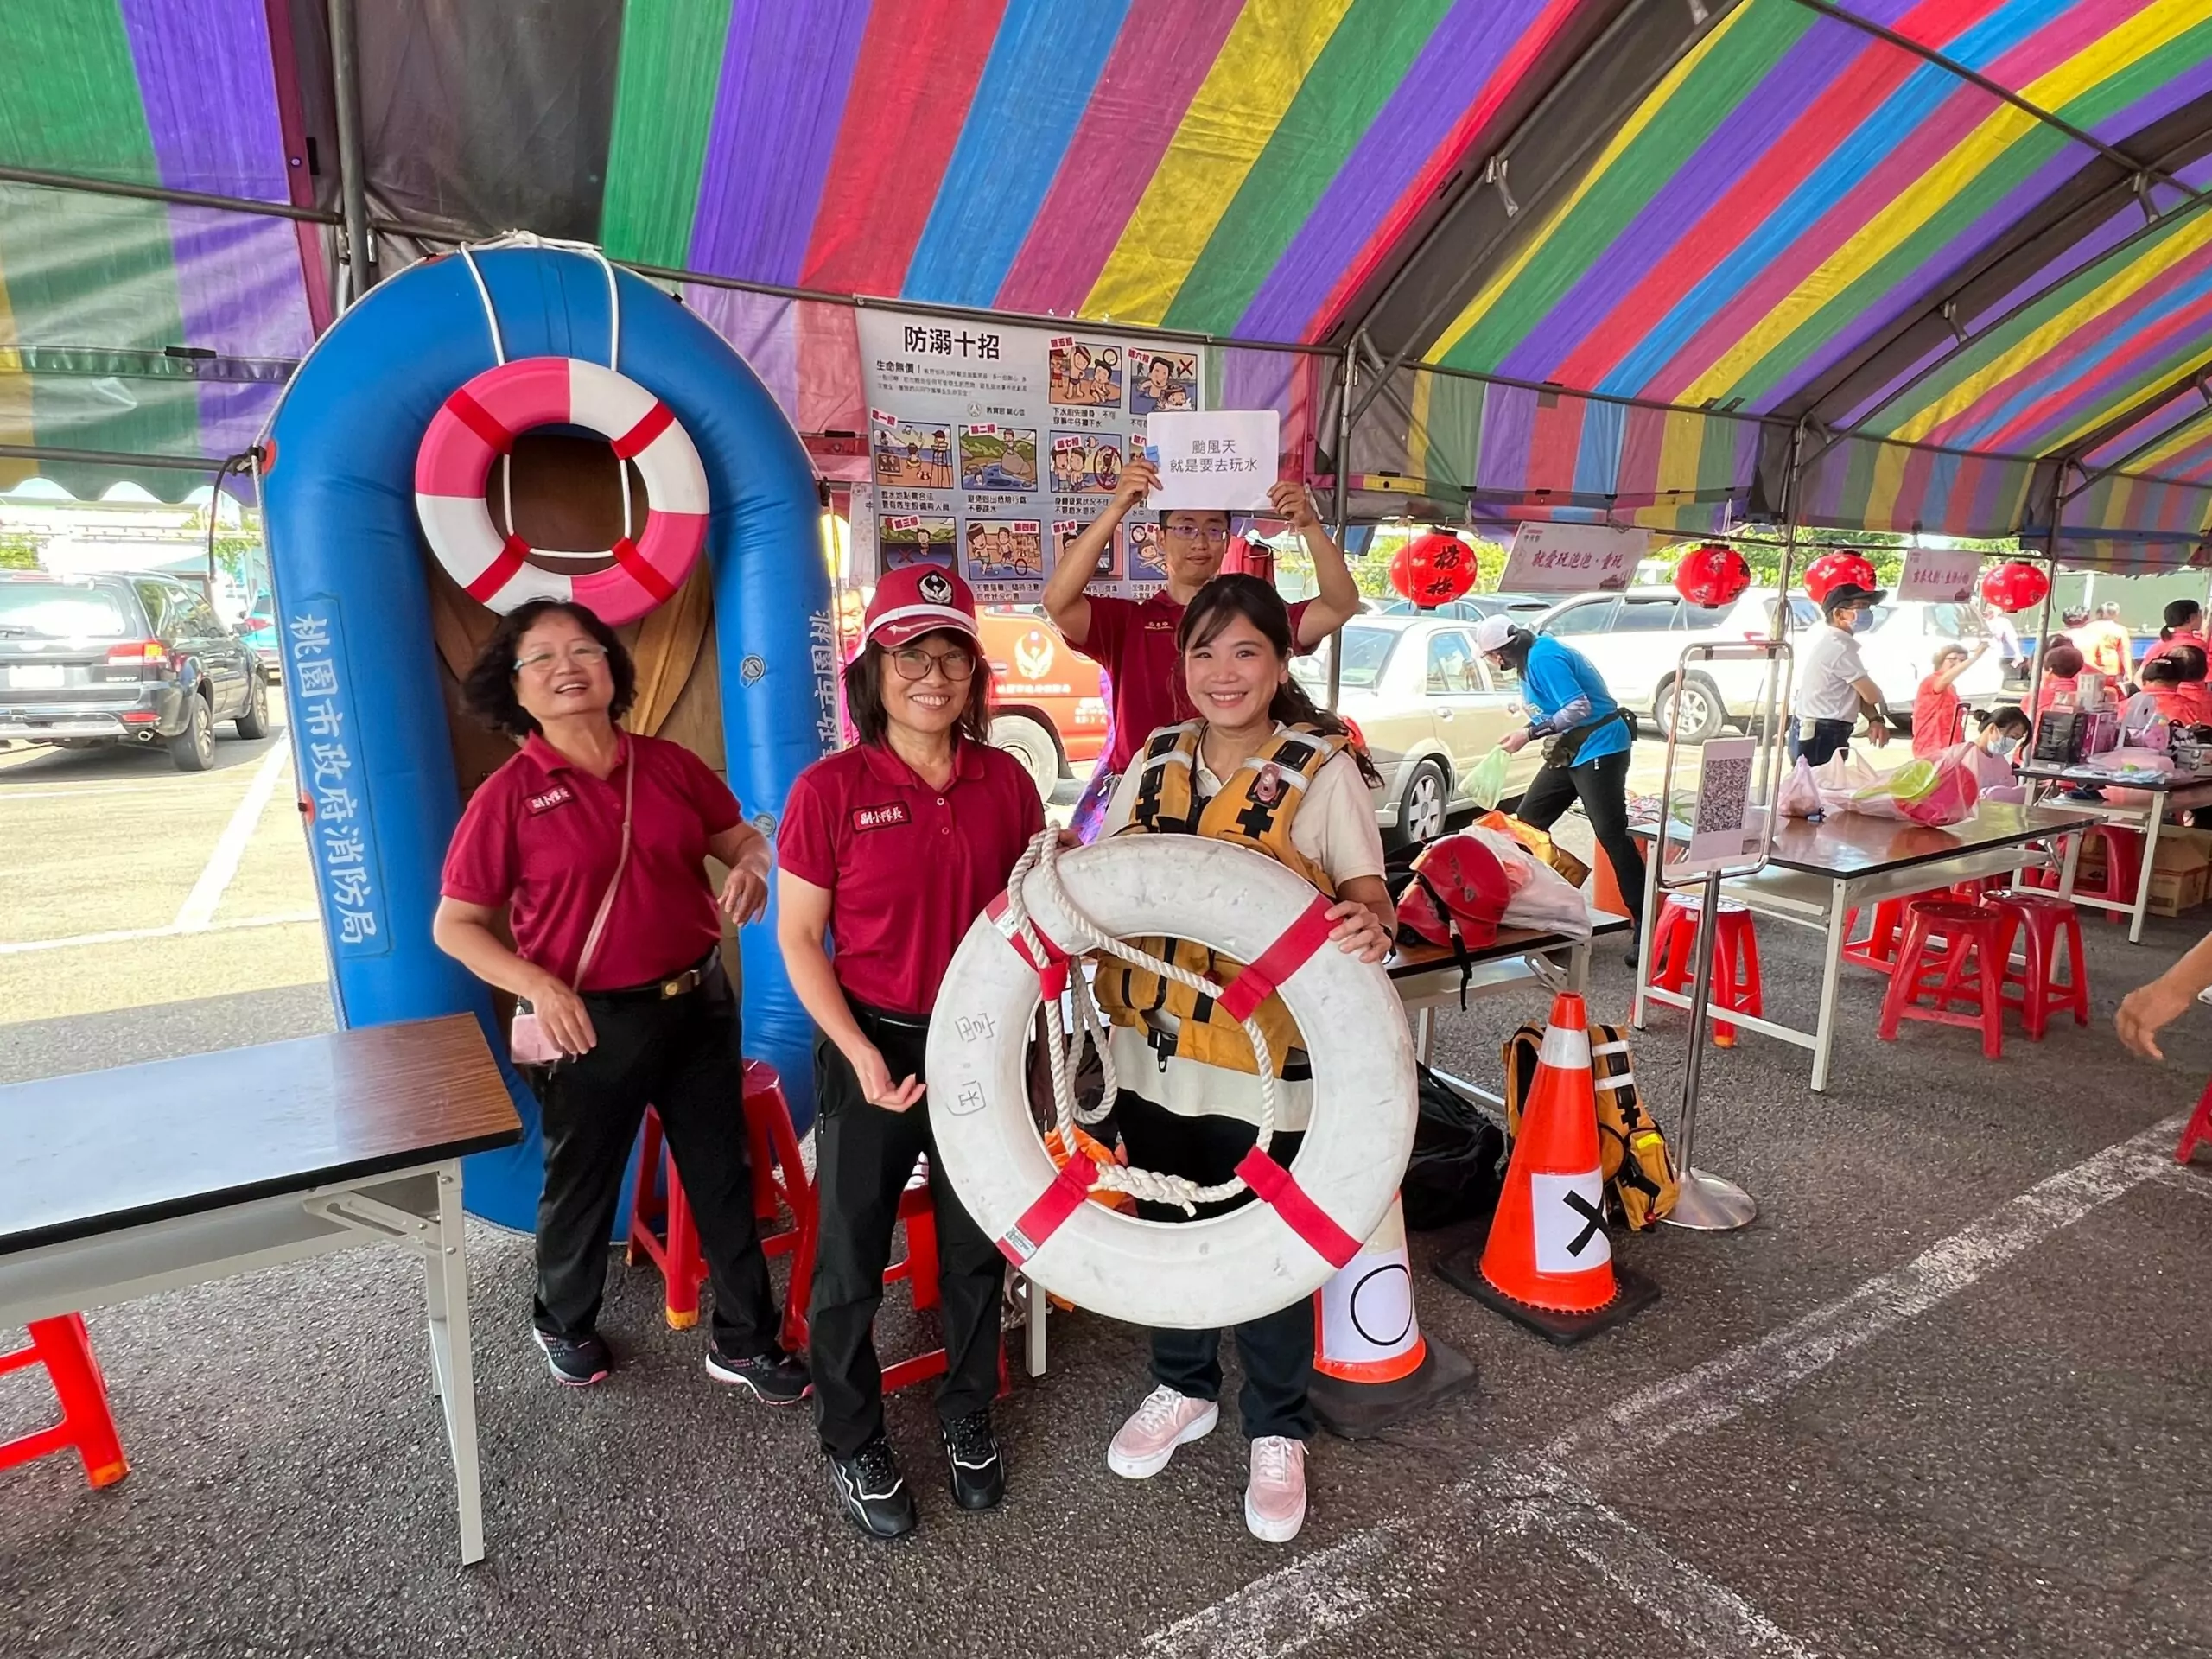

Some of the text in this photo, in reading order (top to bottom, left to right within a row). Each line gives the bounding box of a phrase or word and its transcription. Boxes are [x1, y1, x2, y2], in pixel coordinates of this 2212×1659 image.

[904, 326, 1000, 360] 防溺十招
[1192, 439, 1236, 454] 颱風天
[1170, 458, 1258, 474] 就是要去玩水
[288, 613, 378, 945] 桃園市政府消防局
